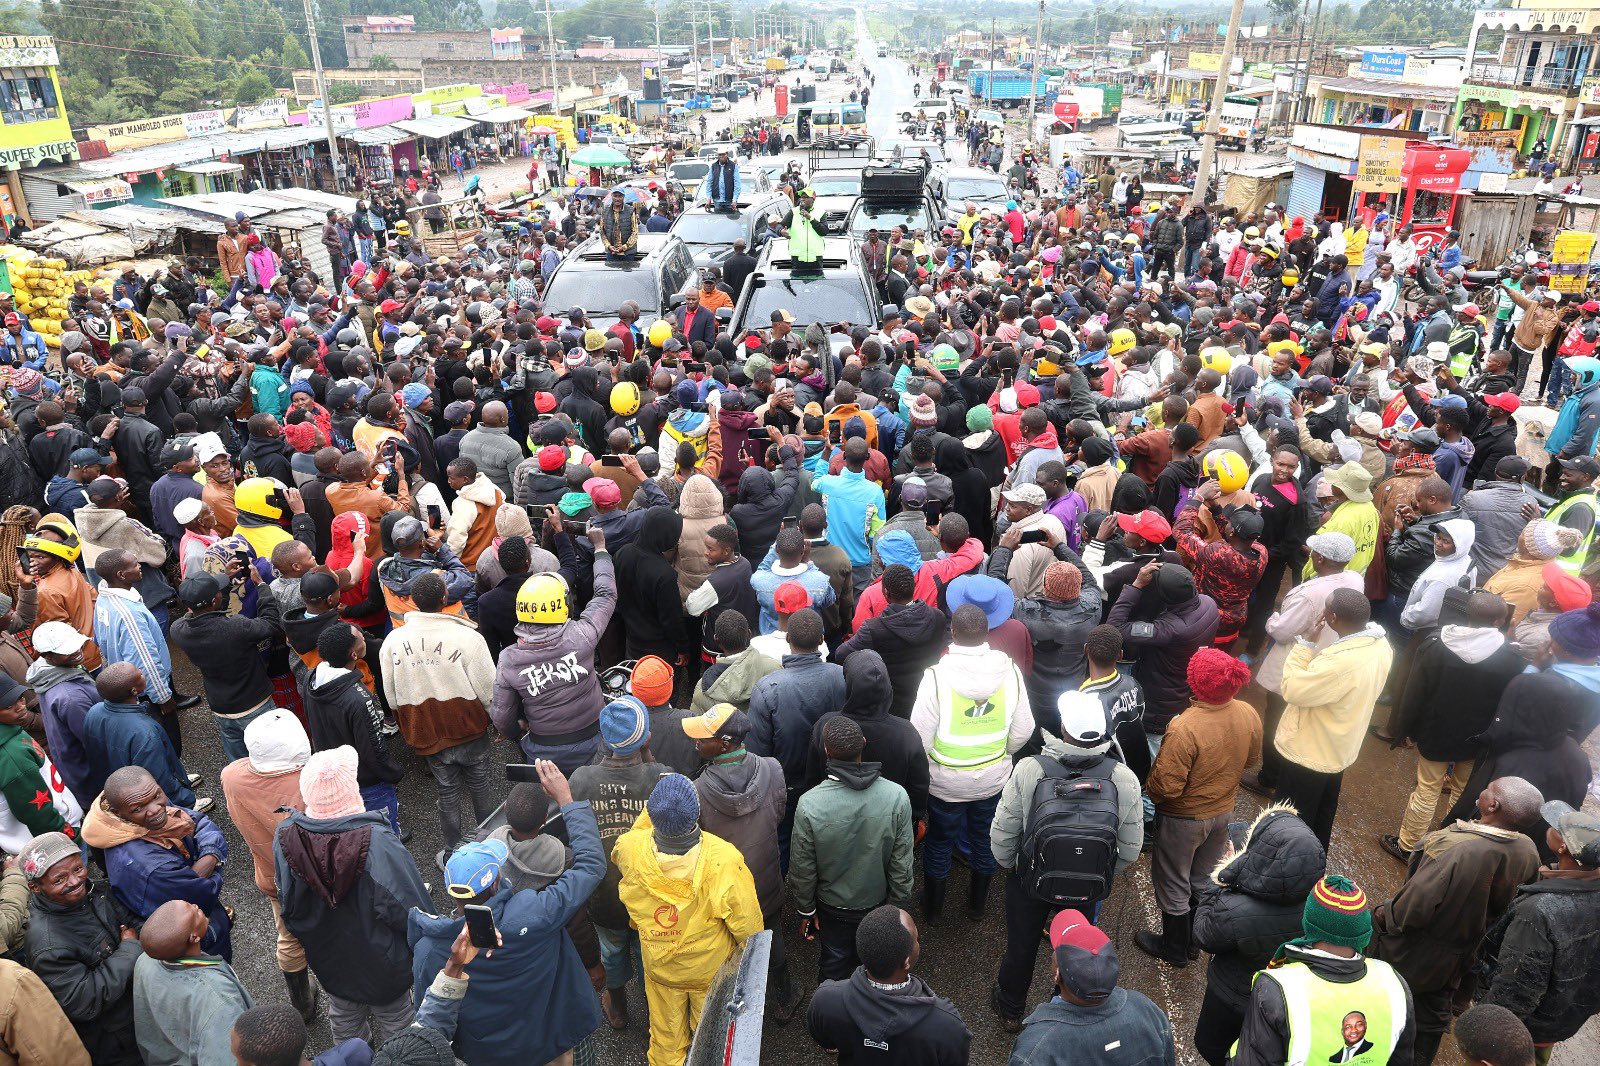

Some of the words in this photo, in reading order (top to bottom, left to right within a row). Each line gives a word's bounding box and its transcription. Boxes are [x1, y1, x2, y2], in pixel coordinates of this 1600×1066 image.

[108, 126, 125, 137] NEW
[127, 122, 161, 134] MAMBOLEO
[163, 118, 183, 129] STORES
[0, 146, 36, 163] SUPER
[39, 141, 77, 158] STORES
[1366, 168, 1387, 176] SCHOOLS
[600, 784, 627, 796] CITY
